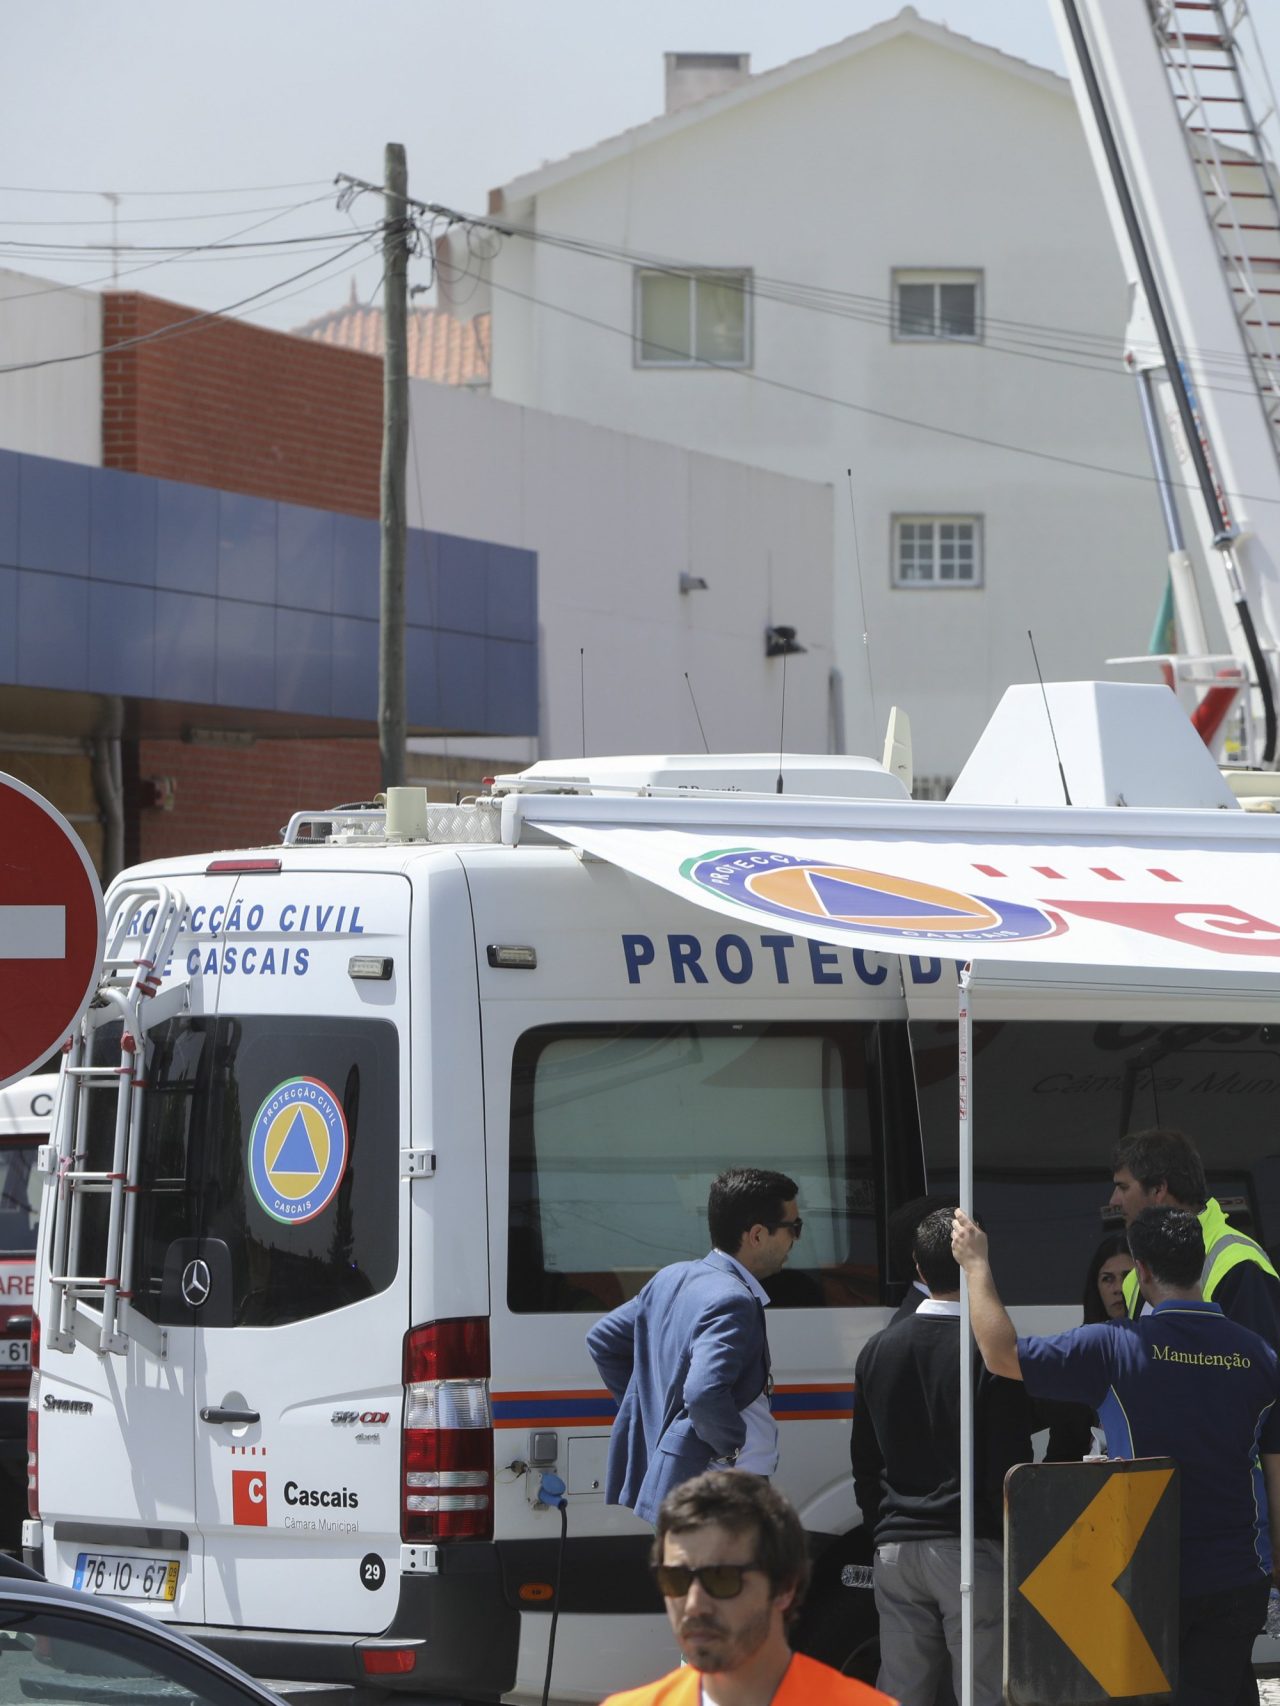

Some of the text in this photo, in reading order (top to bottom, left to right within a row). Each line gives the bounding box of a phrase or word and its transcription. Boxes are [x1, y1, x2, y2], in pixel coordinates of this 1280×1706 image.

[279, 904, 365, 933] CIVIL
[186, 947, 310, 976] CASCAIS
[262, 1087, 337, 1127] PROTECÇÃO CIVIL
[274, 1200, 312, 1214] CASCAIS
[1152, 1344, 1251, 1370] Manutenção
[360, 1411, 390, 1424] CDI
[284, 1481, 359, 1509] Cascais
[284, 1516, 359, 1535] Câmara Municipal
[364, 1564, 381, 1580] 29
